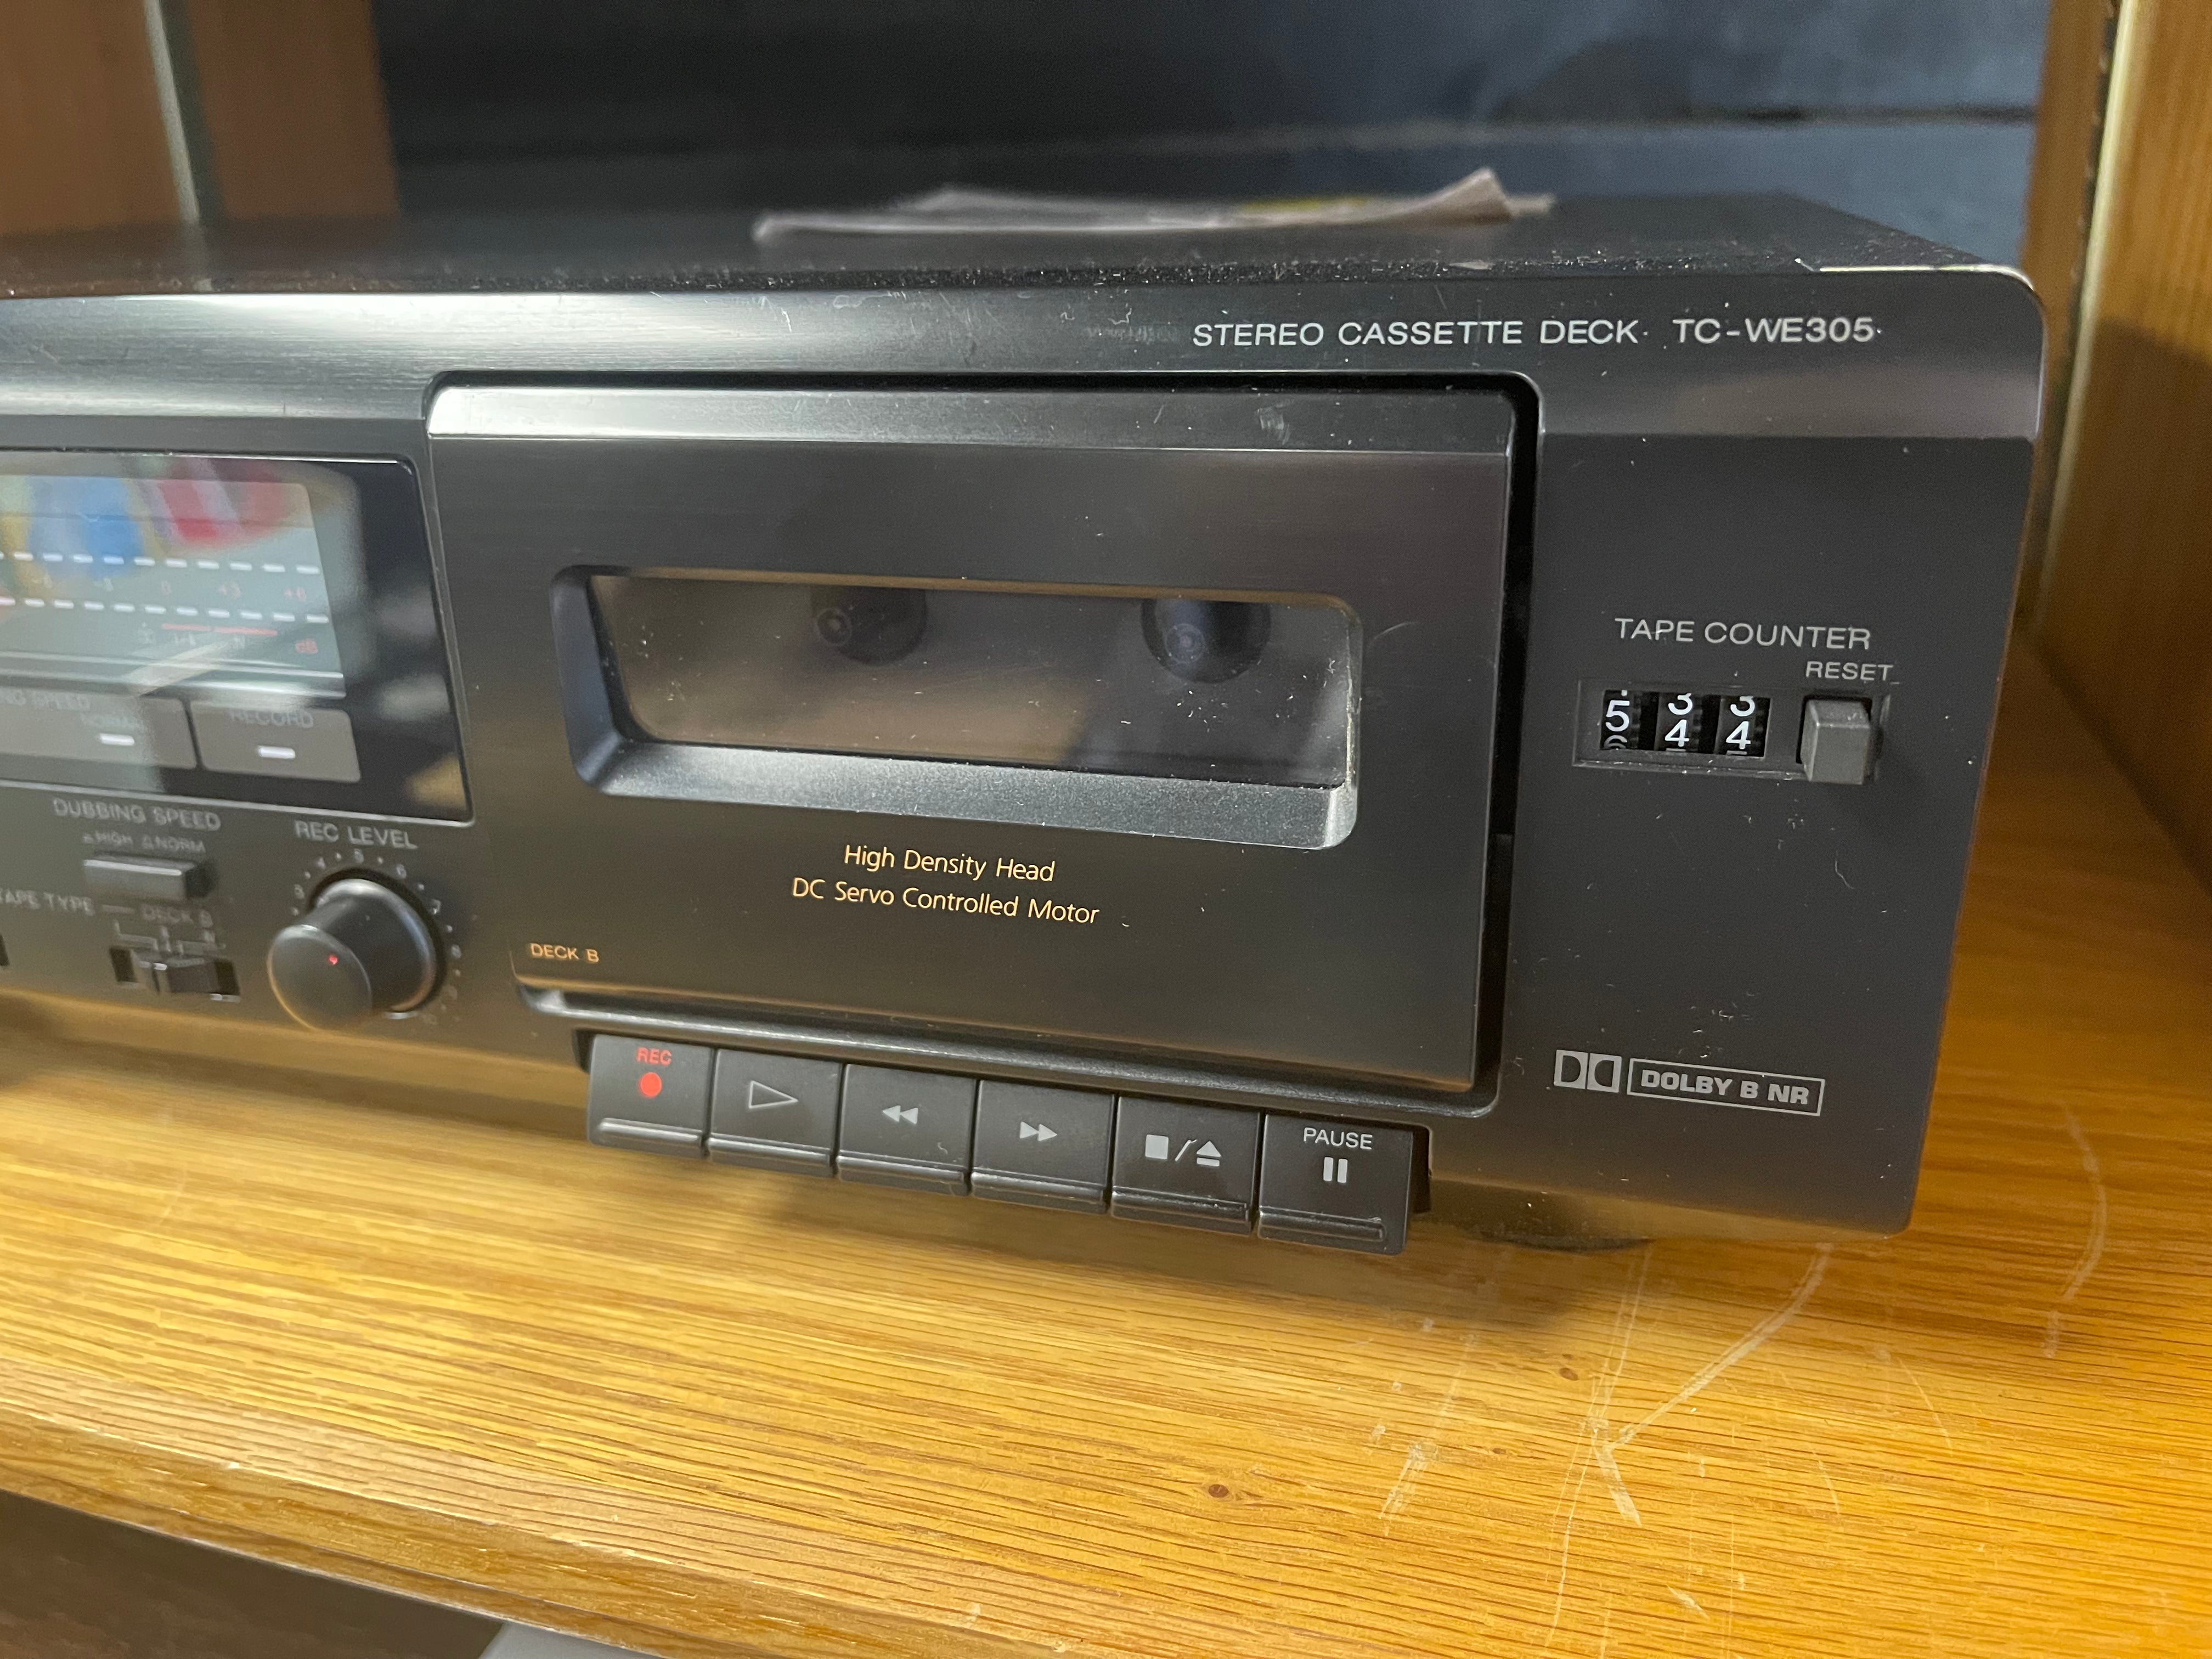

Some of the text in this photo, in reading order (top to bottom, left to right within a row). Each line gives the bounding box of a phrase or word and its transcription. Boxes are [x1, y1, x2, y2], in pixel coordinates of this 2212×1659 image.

[1192, 317, 1875, 347] STEREO CASSETTE DECK TC-WE305
[1615, 618, 1870, 650] TAPE COUNTER
[1805, 661, 1893, 681] RESET
[53, 797, 222, 831] DUBBING SPEED
[295, 820, 419, 849] REC LEVEL
[844, 845, 1055, 882] High Density Head
[43, 891, 95, 916] TYPE
[791, 878, 1101, 924] DC Servo Controlled Motor
[530, 943, 600, 963] DECK B
[635, 1046, 672, 1066] REC
[1641, 1069, 1809, 1105] DOLBY B NR
[1302, 1127, 1373, 1152] PAUSE
